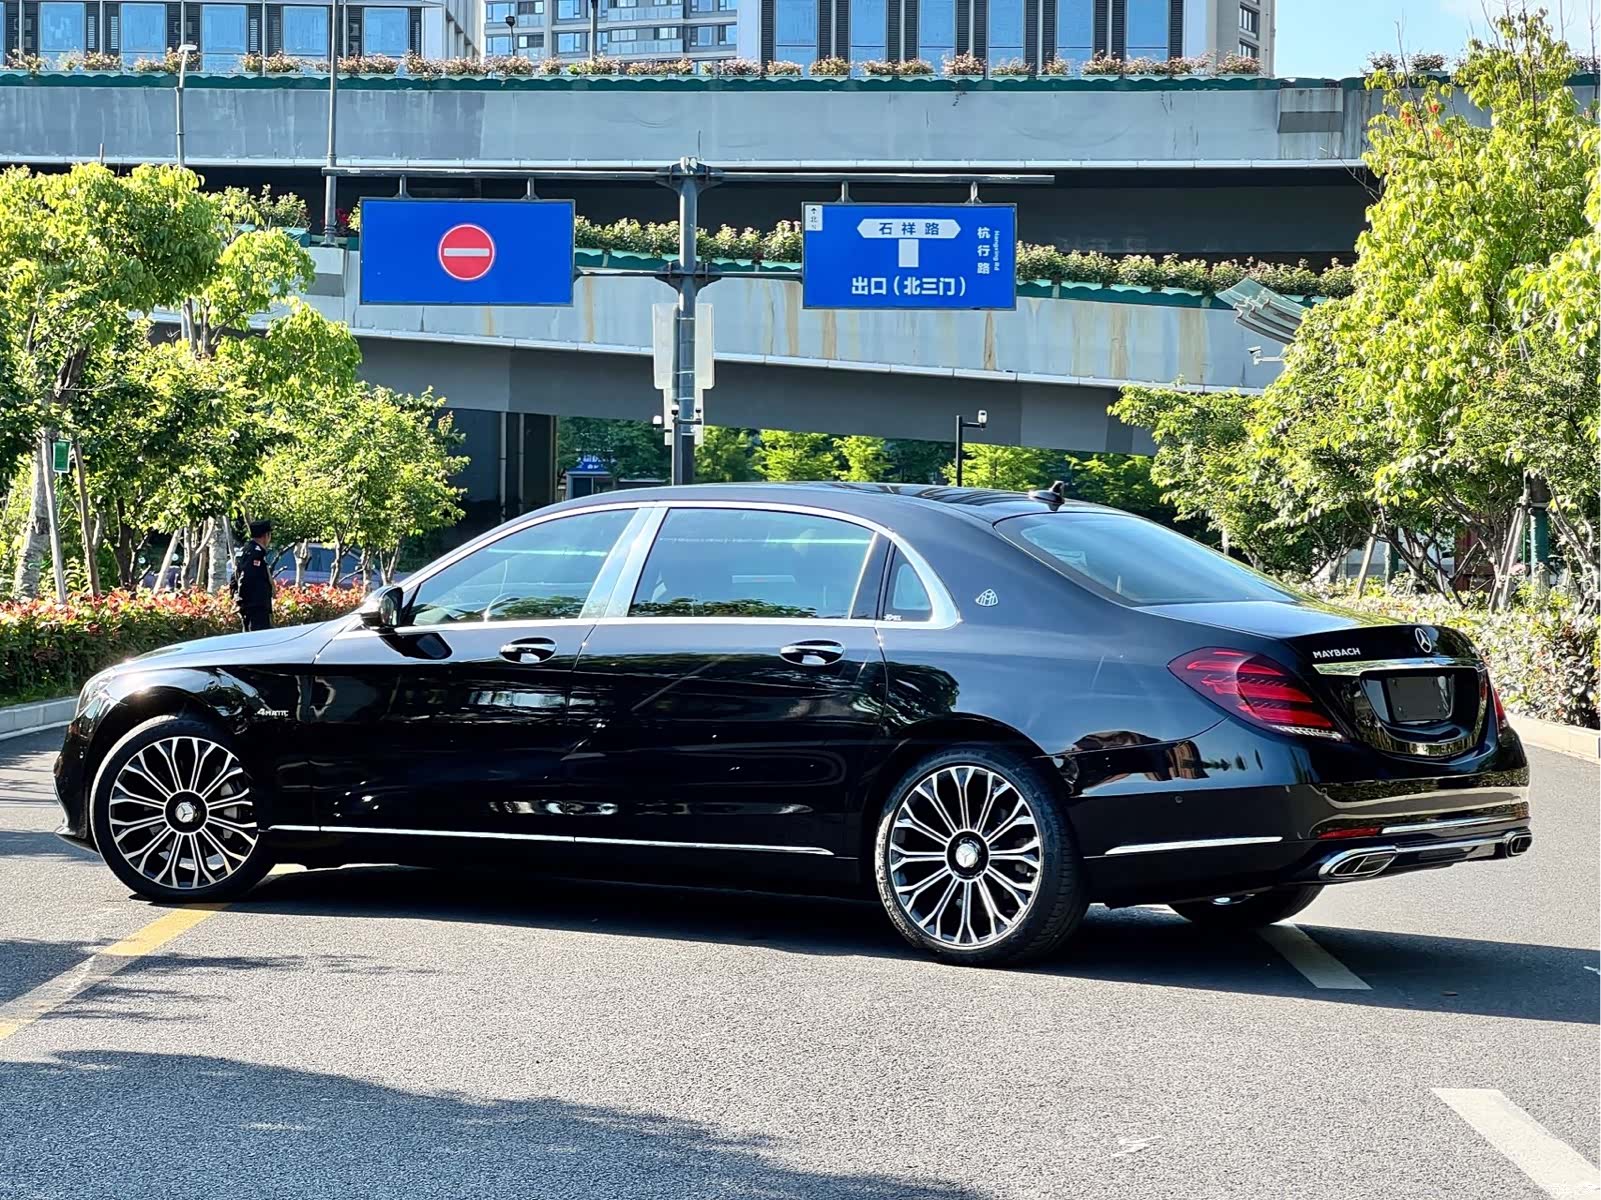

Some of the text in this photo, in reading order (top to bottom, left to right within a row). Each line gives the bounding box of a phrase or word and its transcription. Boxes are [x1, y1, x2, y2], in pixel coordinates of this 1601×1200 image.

[878, 222, 940, 236] 石祥路
[977, 226, 991, 275] 杭行路
[1312, 647, 1361, 659] MAYBACH
